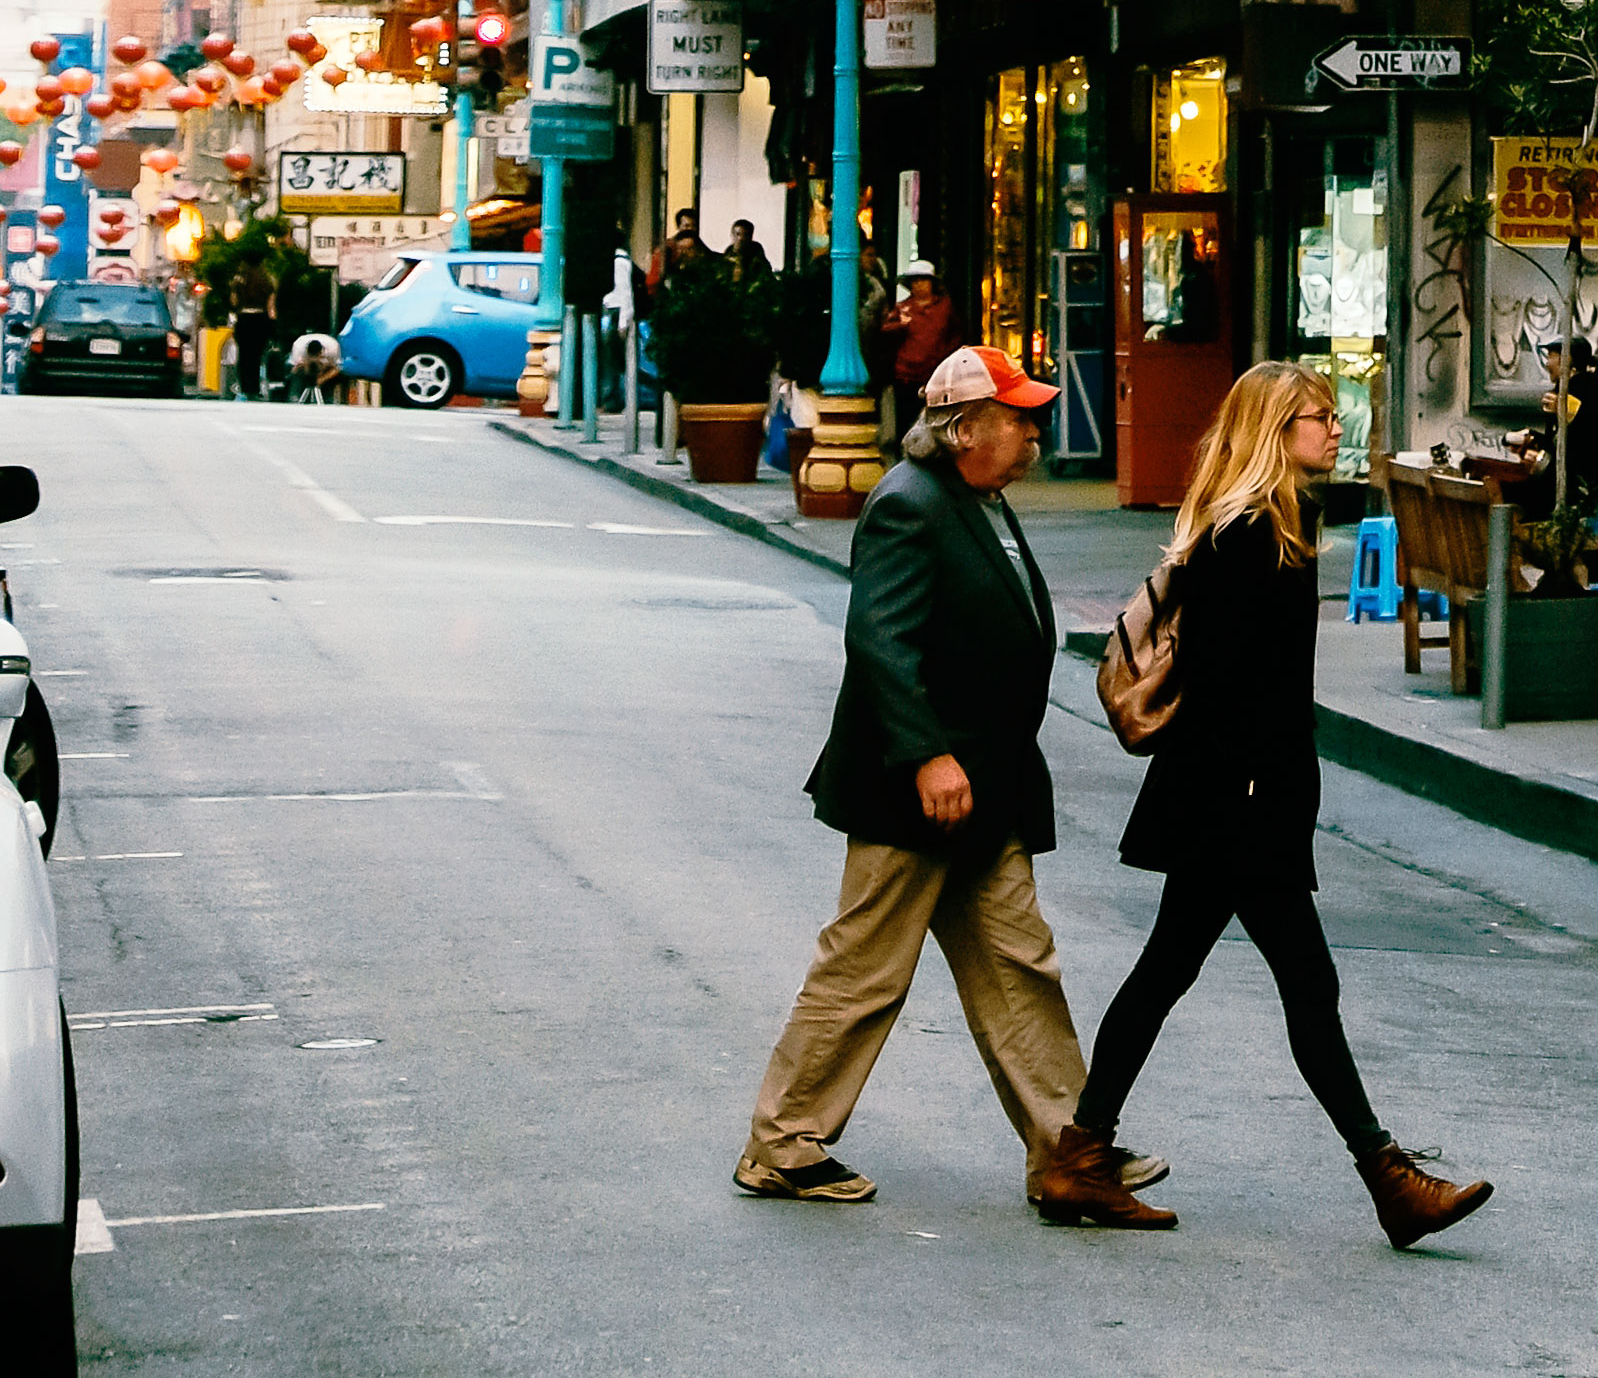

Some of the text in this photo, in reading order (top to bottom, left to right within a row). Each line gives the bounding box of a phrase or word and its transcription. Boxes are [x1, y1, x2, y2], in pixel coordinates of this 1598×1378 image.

[673, 35, 723, 53] MUST
[544, 46, 580, 89] P
[1359, 53, 1452, 73] ONE WAY
